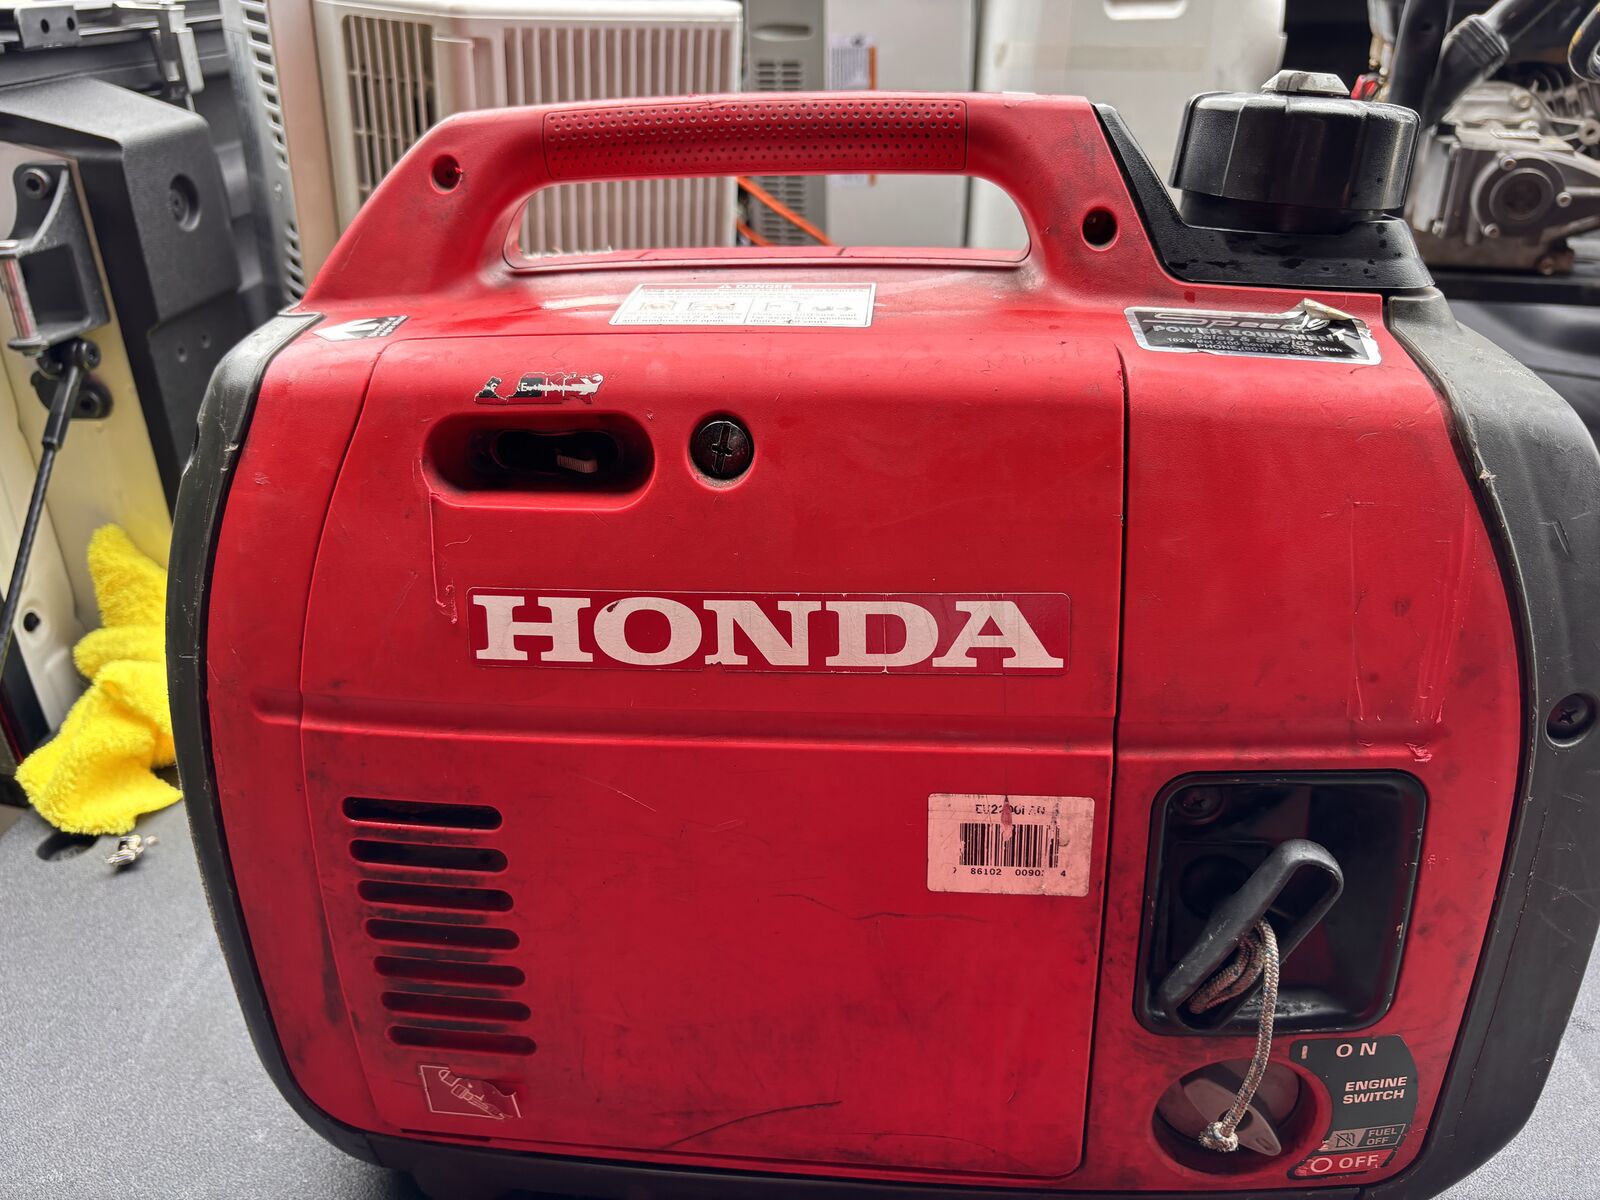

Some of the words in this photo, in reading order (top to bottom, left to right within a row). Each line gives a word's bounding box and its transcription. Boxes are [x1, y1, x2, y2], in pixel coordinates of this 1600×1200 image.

[1152, 325, 1225, 335] POWER
[1229, 328, 1346, 341] EQUIPMENT
[1256, 336, 1314, 346] Service
[473, 594, 1064, 668] HONDA
[970, 867, 1002, 876] 86102
[1336, 1042, 1377, 1057] ON
[1345, 1077, 1407, 1091] ENGINE
[1343, 1089, 1405, 1104] SWITCH
[1368, 1127, 1397, 1137] FUEL
[1366, 1136, 1389, 1145] OFF
[1339, 1154, 1379, 1169] OFF
